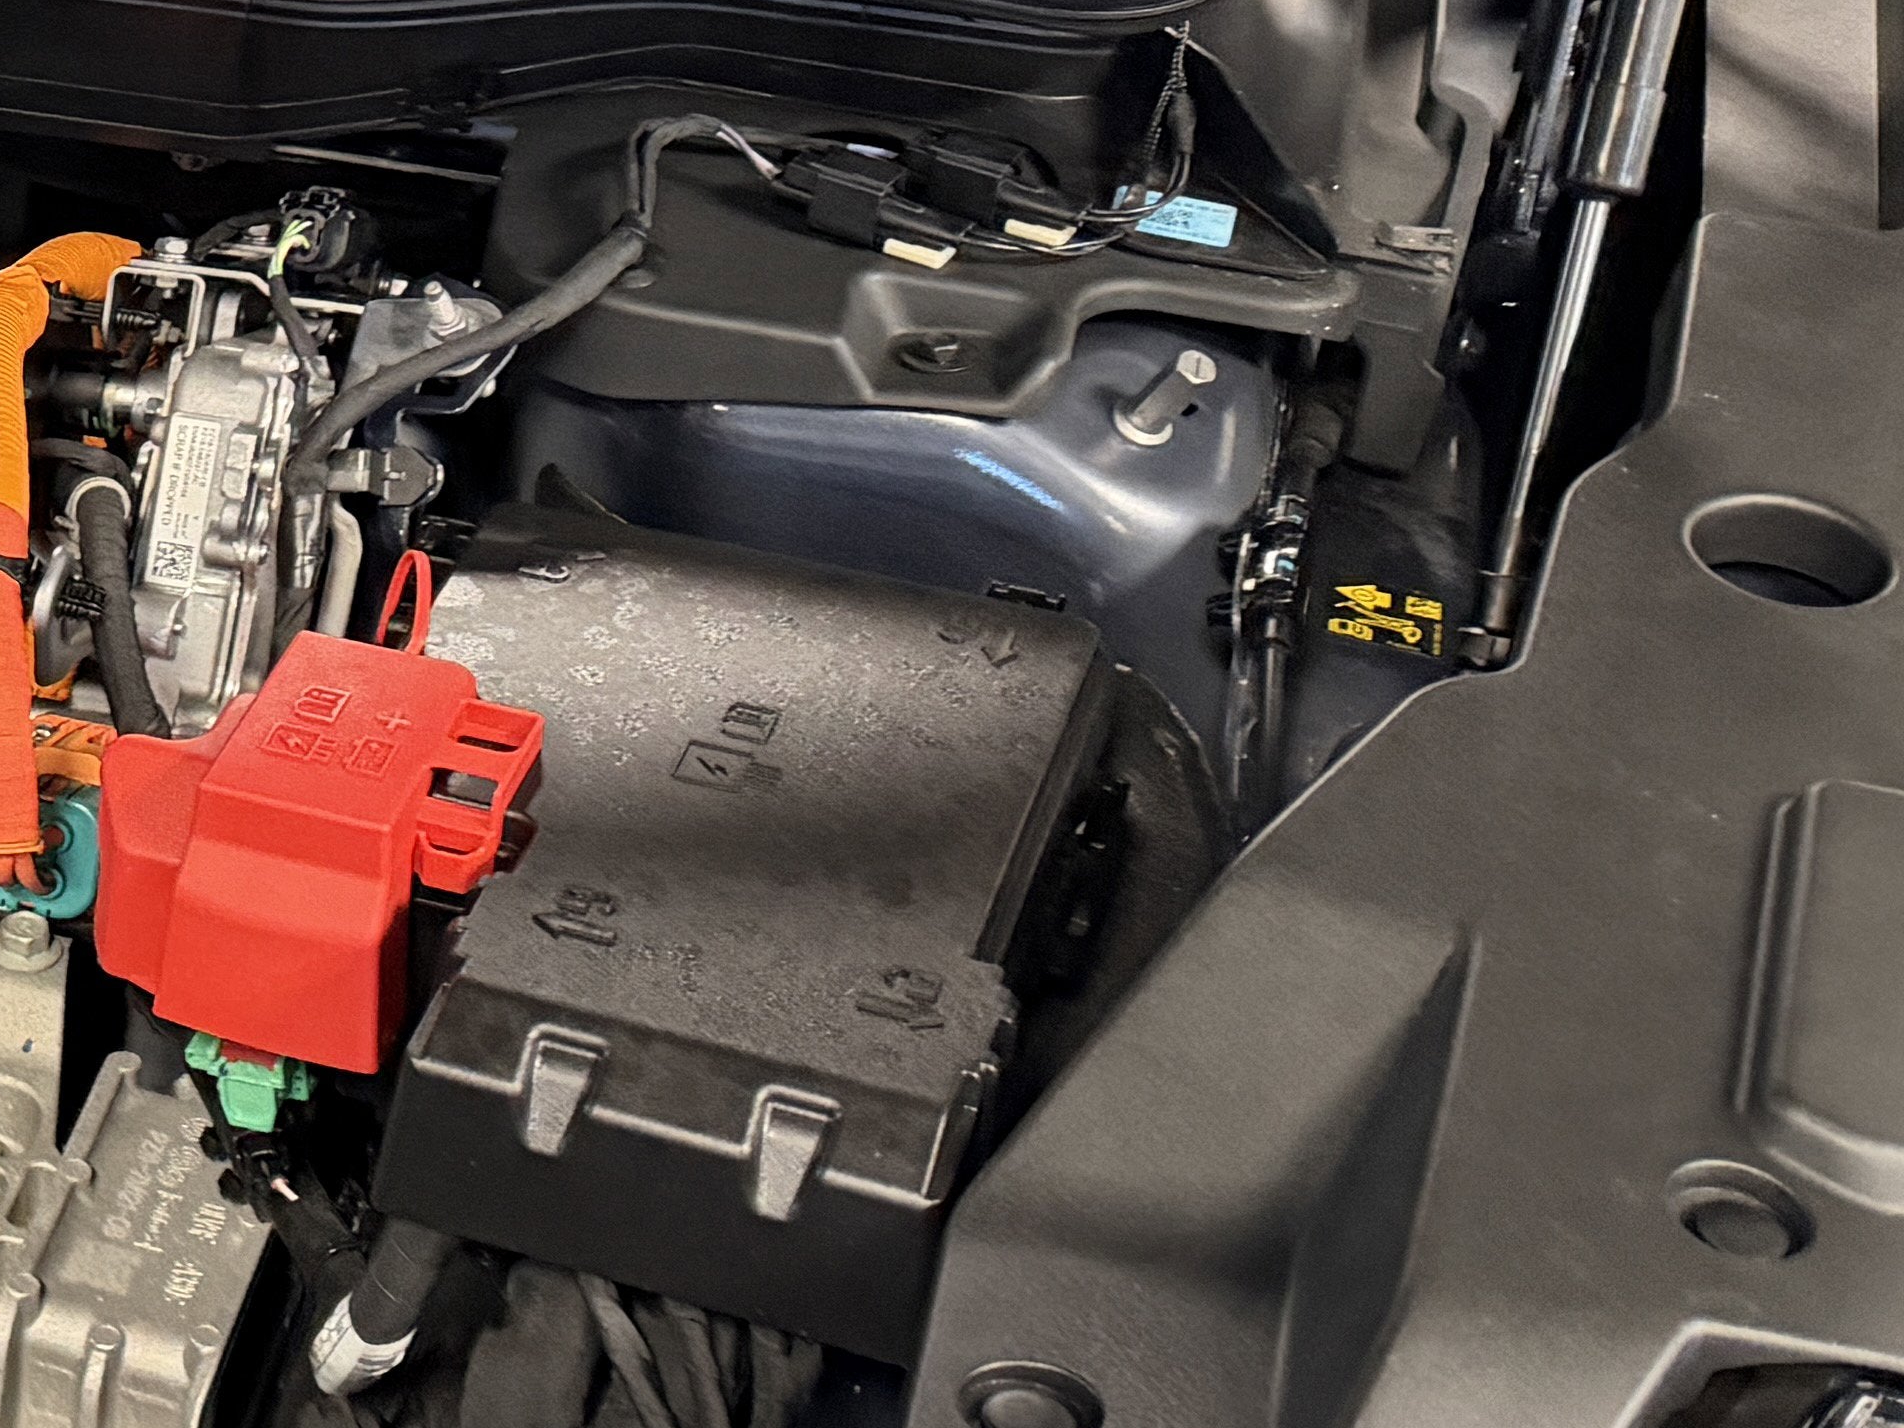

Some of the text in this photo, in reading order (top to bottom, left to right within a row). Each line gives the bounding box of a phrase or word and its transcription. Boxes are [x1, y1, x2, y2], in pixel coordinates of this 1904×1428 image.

[160, 423, 188, 527] SCRAP IF DROPPED
